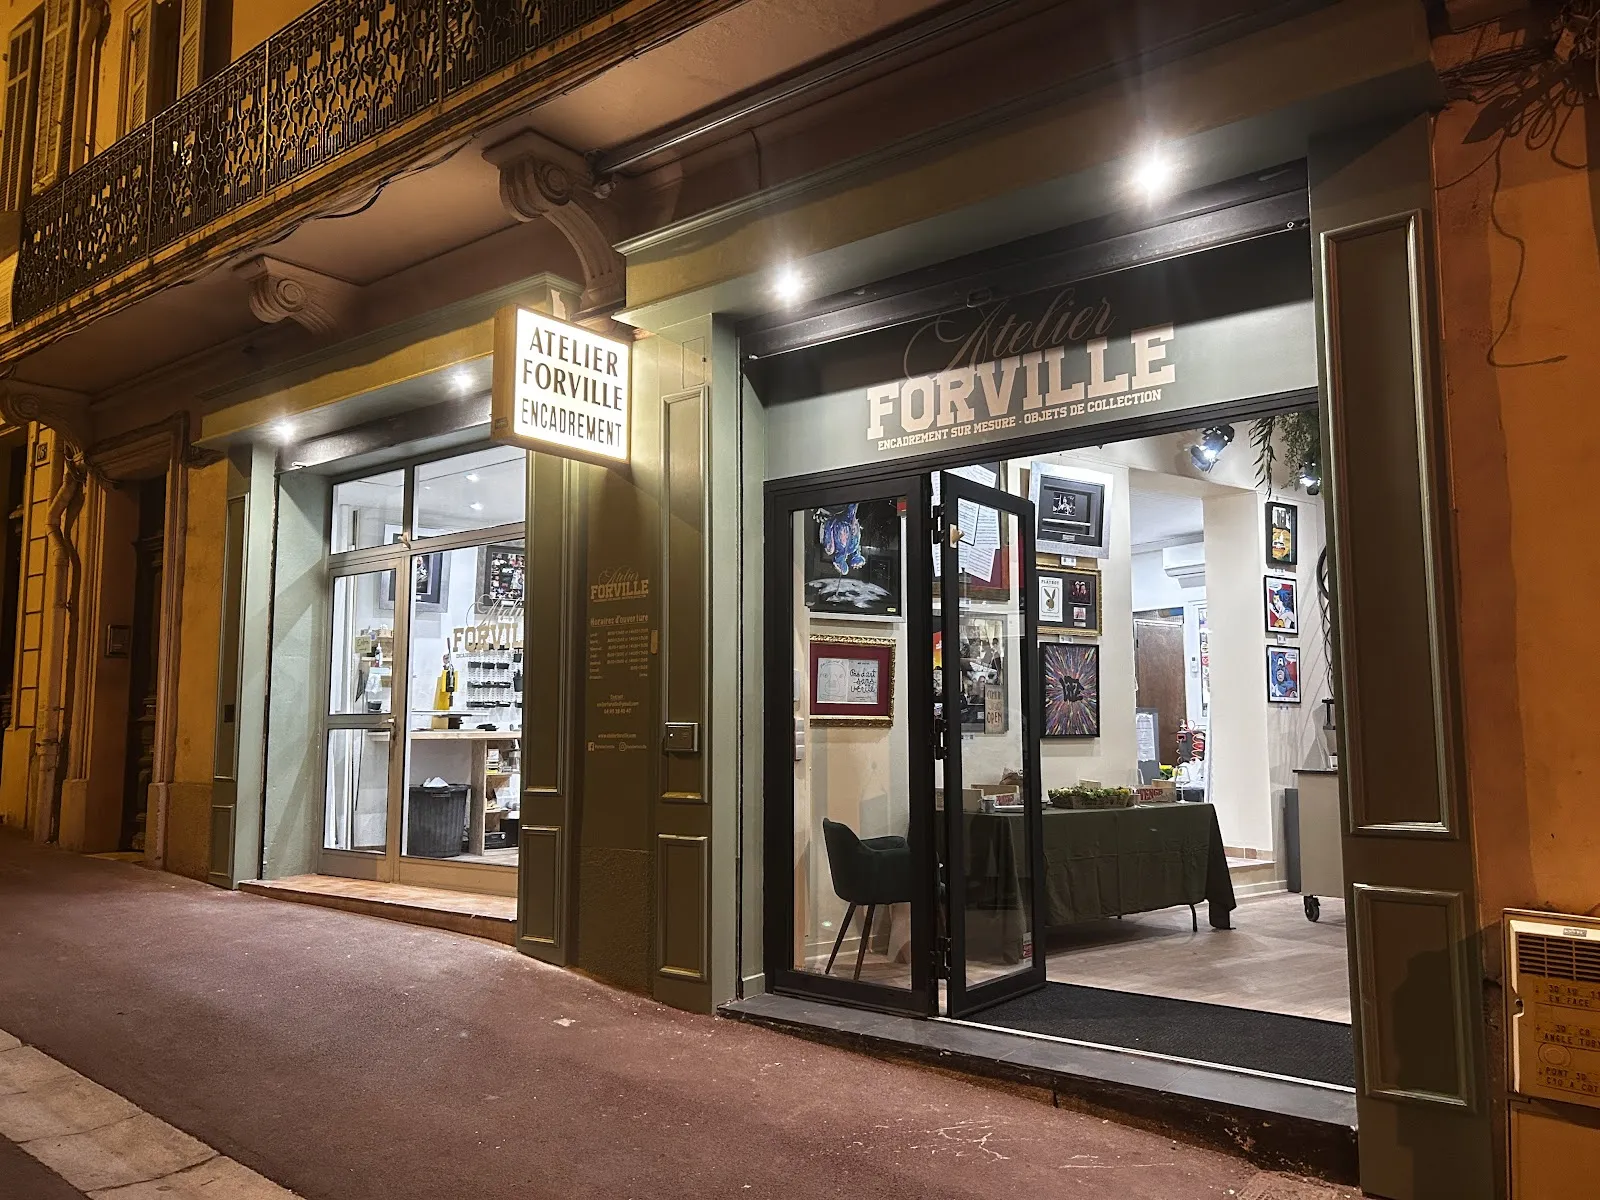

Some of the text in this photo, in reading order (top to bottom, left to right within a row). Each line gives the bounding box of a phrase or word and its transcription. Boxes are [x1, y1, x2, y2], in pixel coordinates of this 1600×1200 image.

[529, 326, 618, 377] ATELIER
[904, 288, 1119, 382] Atelier
[522, 359, 623, 411] FORVILLE
[866, 322, 1176, 440] FORVILLE
[522, 398, 621, 447] ENCADREMENT
[877, 389, 1161, 451] ENCADREMENT SUR MESURE OBJETS DE COLLECTION
[590, 579, 649, 599] FORVILLE
[986, 711, 1003, 724] OPEN
[1567, 997, 1589, 1008] FACE
[1544, 1033, 1573, 1045] ANGLE
[1546, 1066, 1569, 1077] PONT
